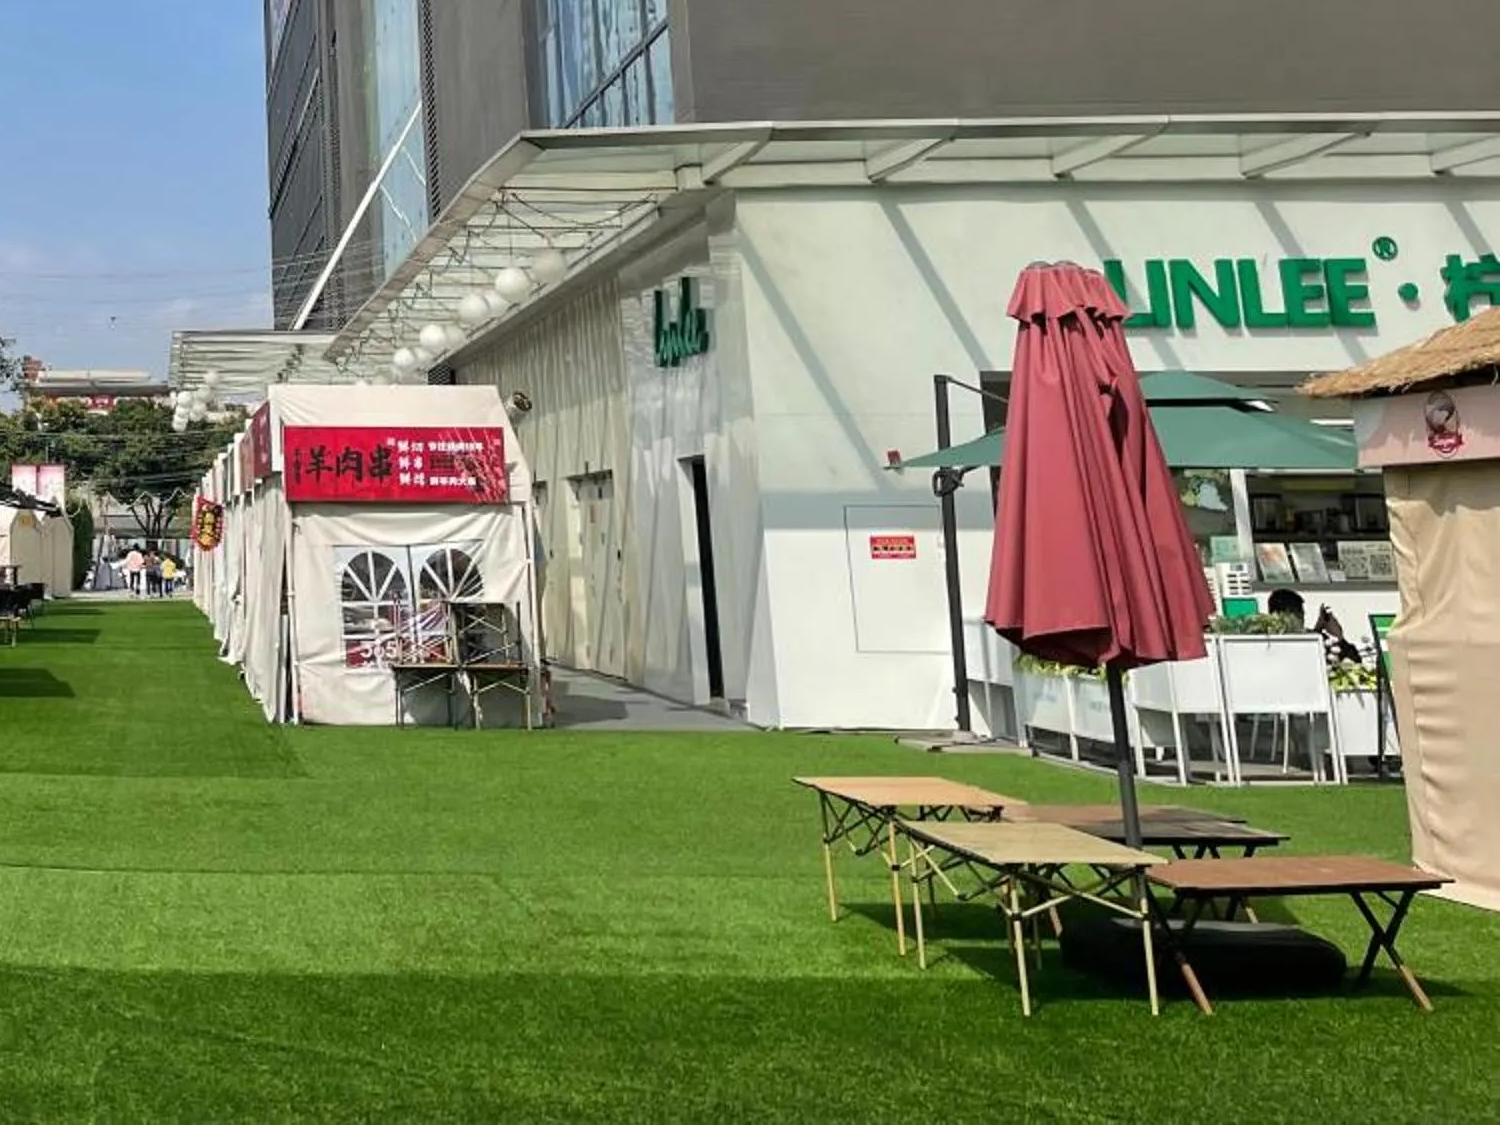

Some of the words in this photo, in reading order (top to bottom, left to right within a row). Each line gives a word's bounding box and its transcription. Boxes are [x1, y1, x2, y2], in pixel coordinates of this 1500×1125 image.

[1103, 258, 1376, 329] LINLEE
[305, 443, 393, 484] 羊肉串
